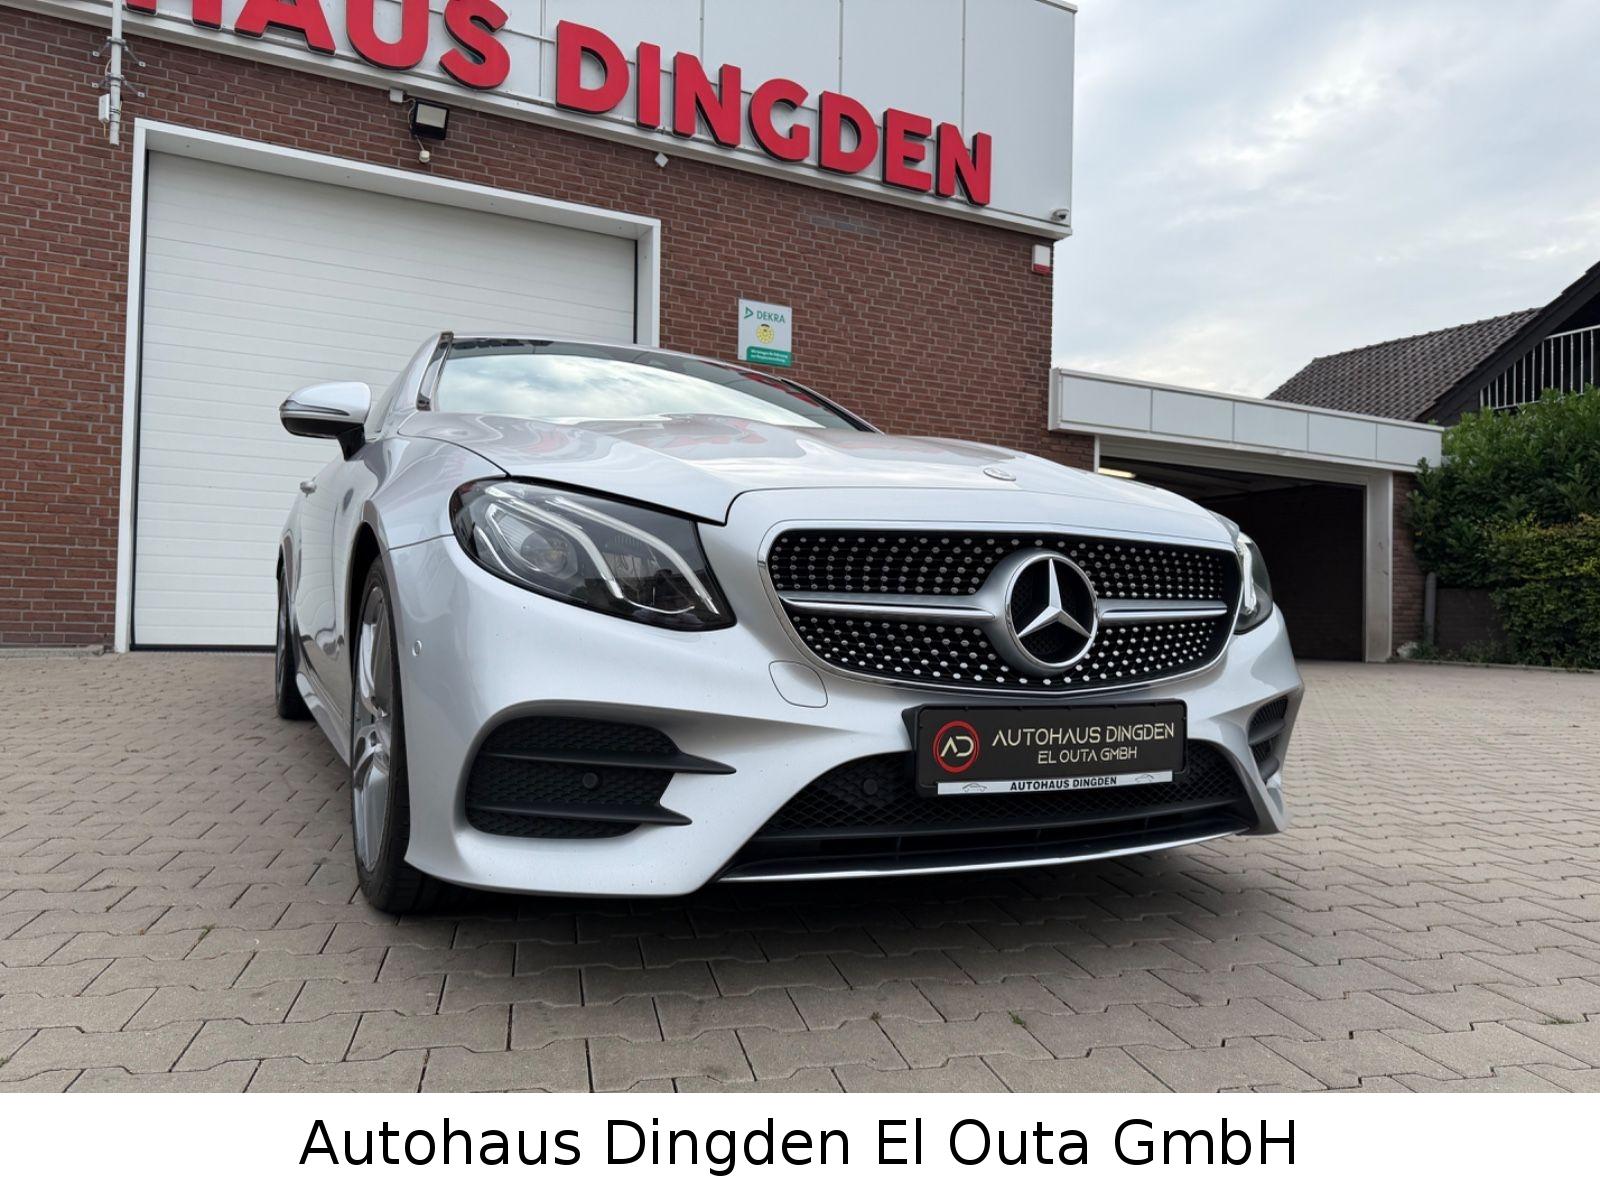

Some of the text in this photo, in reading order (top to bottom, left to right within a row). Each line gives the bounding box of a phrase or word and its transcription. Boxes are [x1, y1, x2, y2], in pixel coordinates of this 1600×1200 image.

[127, 0, 993, 206] AUS DINGDEN
[756, 310, 786, 323] DEKRA
[992, 722, 1175, 747] AUTOHAUS DINGDEN
[1037, 746, 1138, 765] EL OUTA GMBH
[1009, 776, 1118, 791] AUTOHAUS DINGDEN
